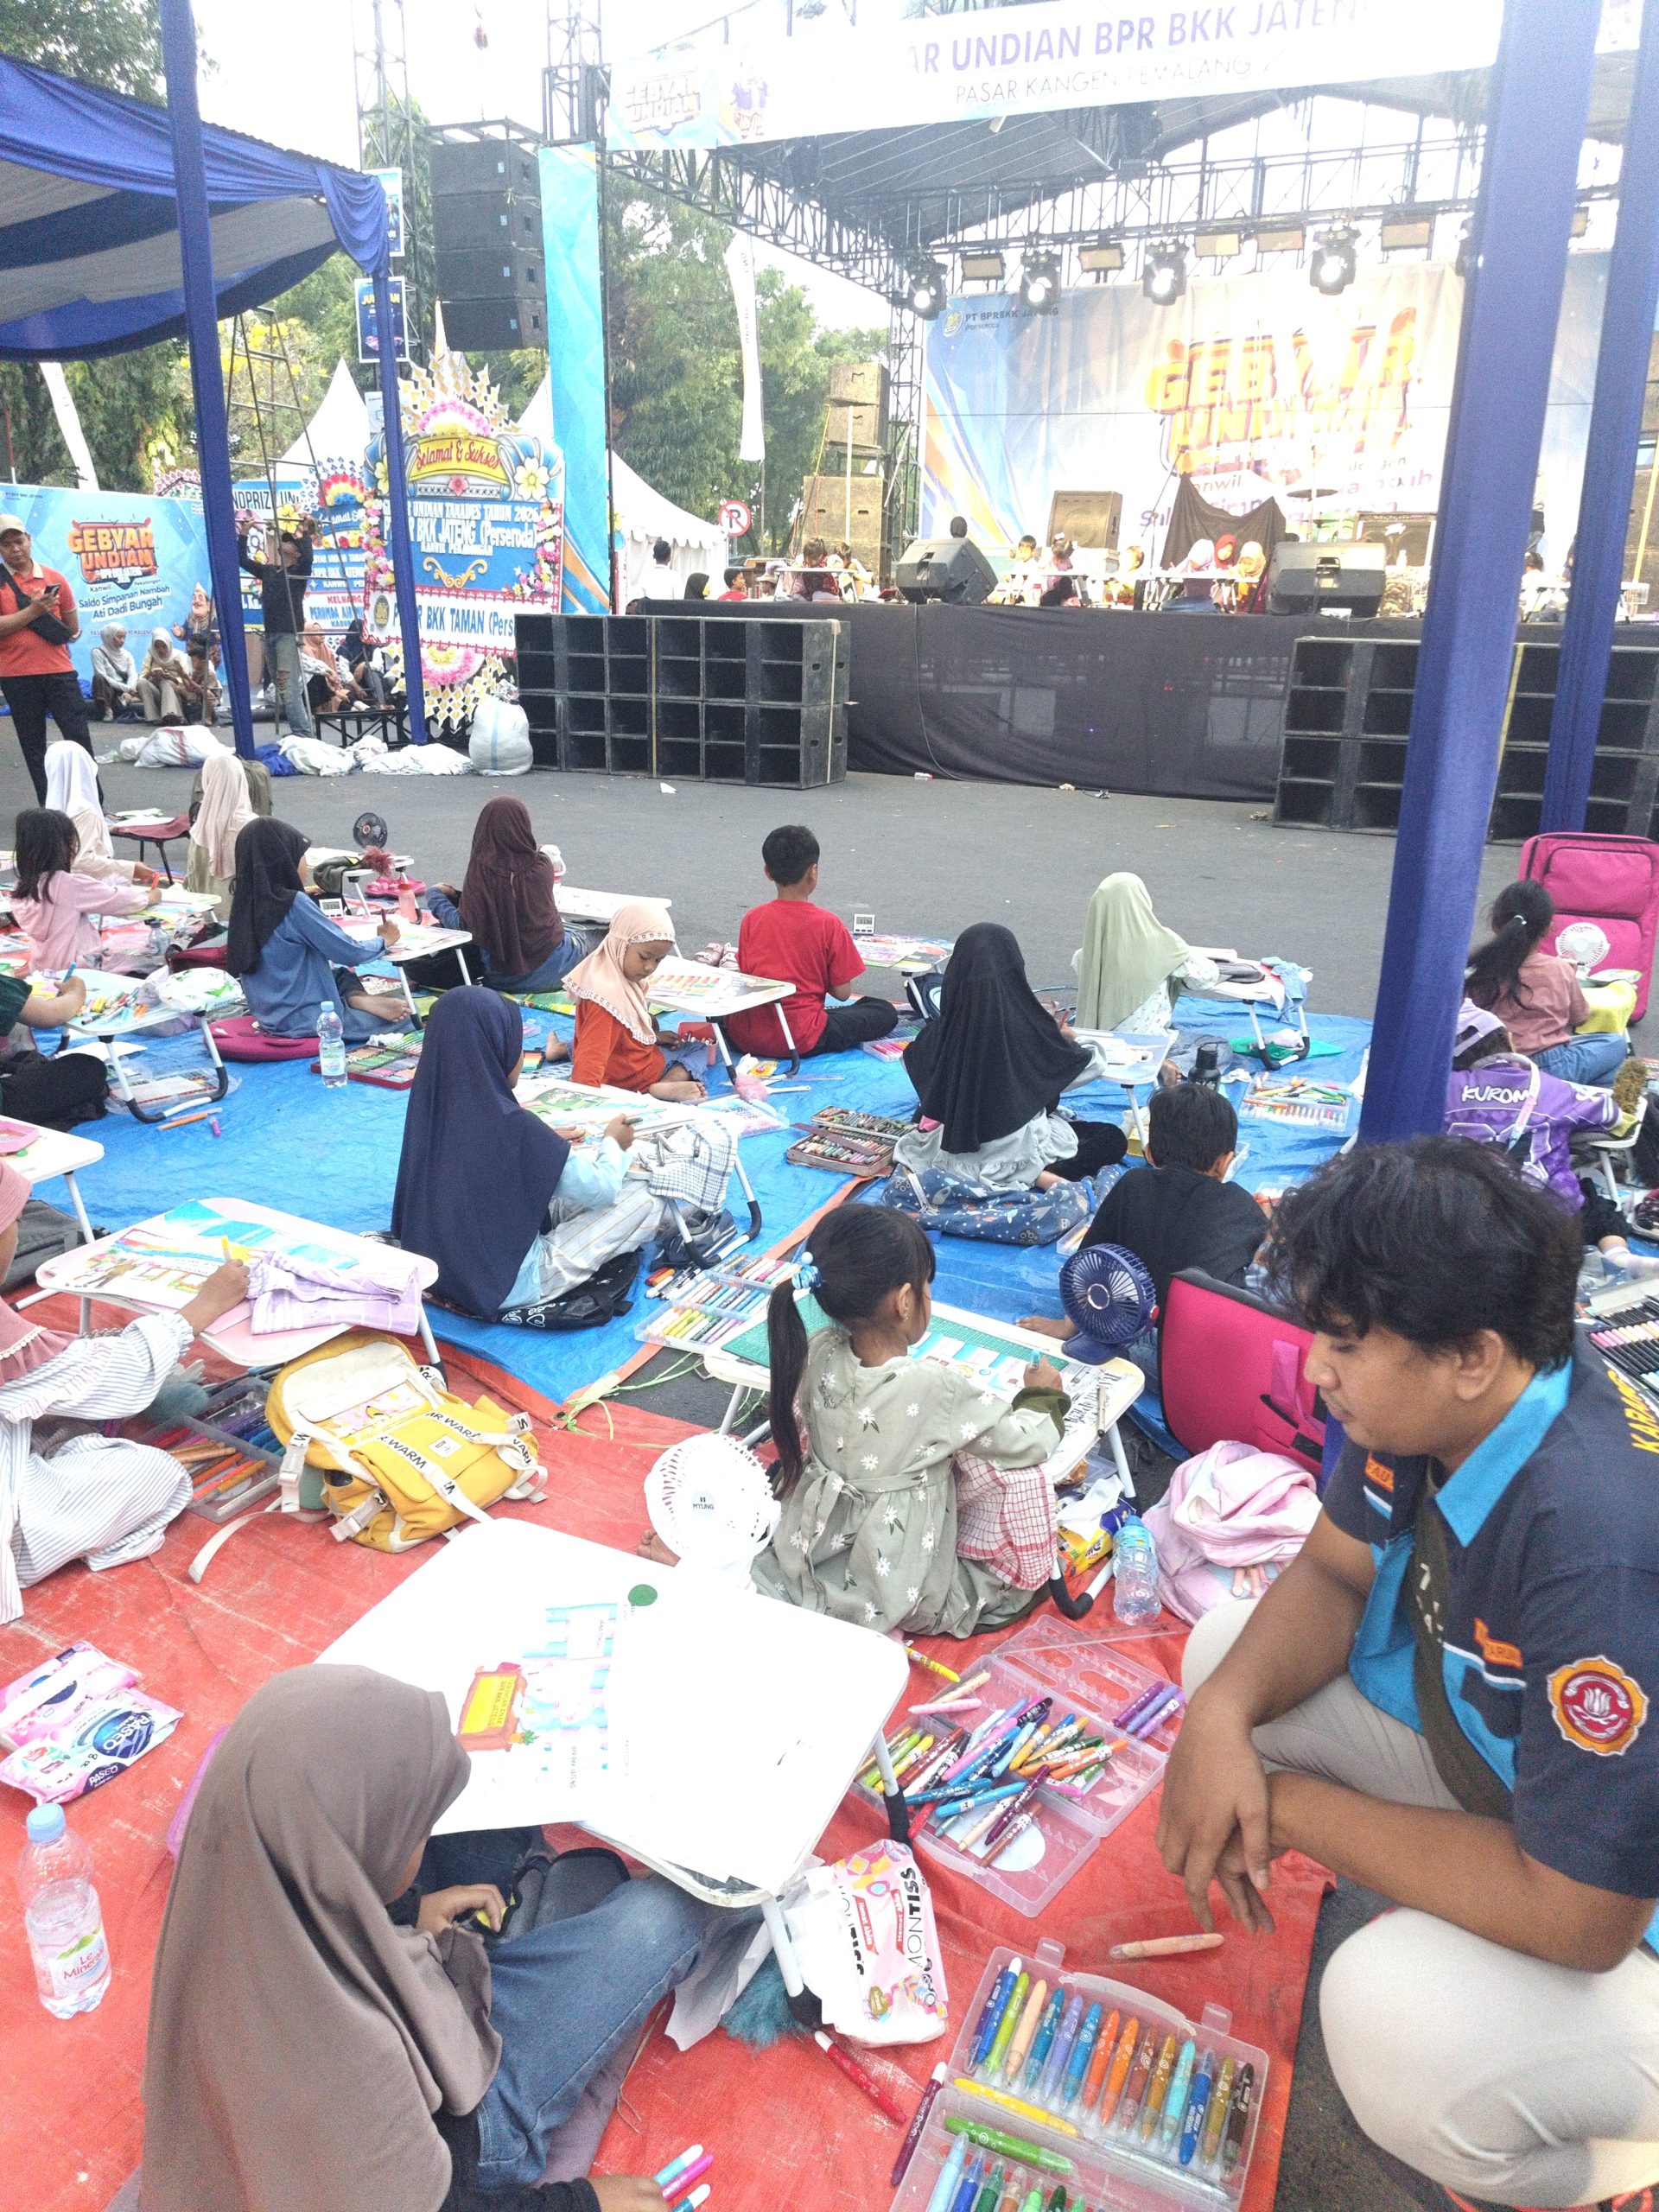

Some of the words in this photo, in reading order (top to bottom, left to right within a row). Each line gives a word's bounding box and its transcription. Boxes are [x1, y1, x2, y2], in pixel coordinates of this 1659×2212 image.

[952, 25, 1081, 71] UNDIAN
[1095, 16, 1154, 54] BPR
[1168, 6, 1236, 46] BKK
[957, 79, 1018, 105] PASAR
[416, 442, 454, 470] Selamat
[465, 442, 502, 470] Sukses
[233, 490, 271, 510] NDPRIZ
[68, 527, 154, 552] GEBYAR
[416, 518, 436, 542] BKK
[439, 521, 476, 545] JATENG
[480, 523, 537, 550] (Perseroda)
[80, 548, 154, 569] UNDIAN
[79, 598, 100, 608] Saldo
[102, 590, 138, 606] Simpanan
[140, 585, 170, 596] Nambah
[90, 583, 112, 592] Kanwil
[92, 607, 105, 619] Ati
[108, 601, 128, 616] Dadi
[130, 596, 162, 611] Bungah
[426, 607, 446, 631] BKK
[449, 607, 484, 634] TAMAN
[488, 611, 514, 637] (Pers
[1462, 1084, 1531, 1104] KUROM
[103, 1715, 150, 1751] PASEO
[88, 1765, 118, 1786] PASEO
[79, 1952, 92, 1965] Le
